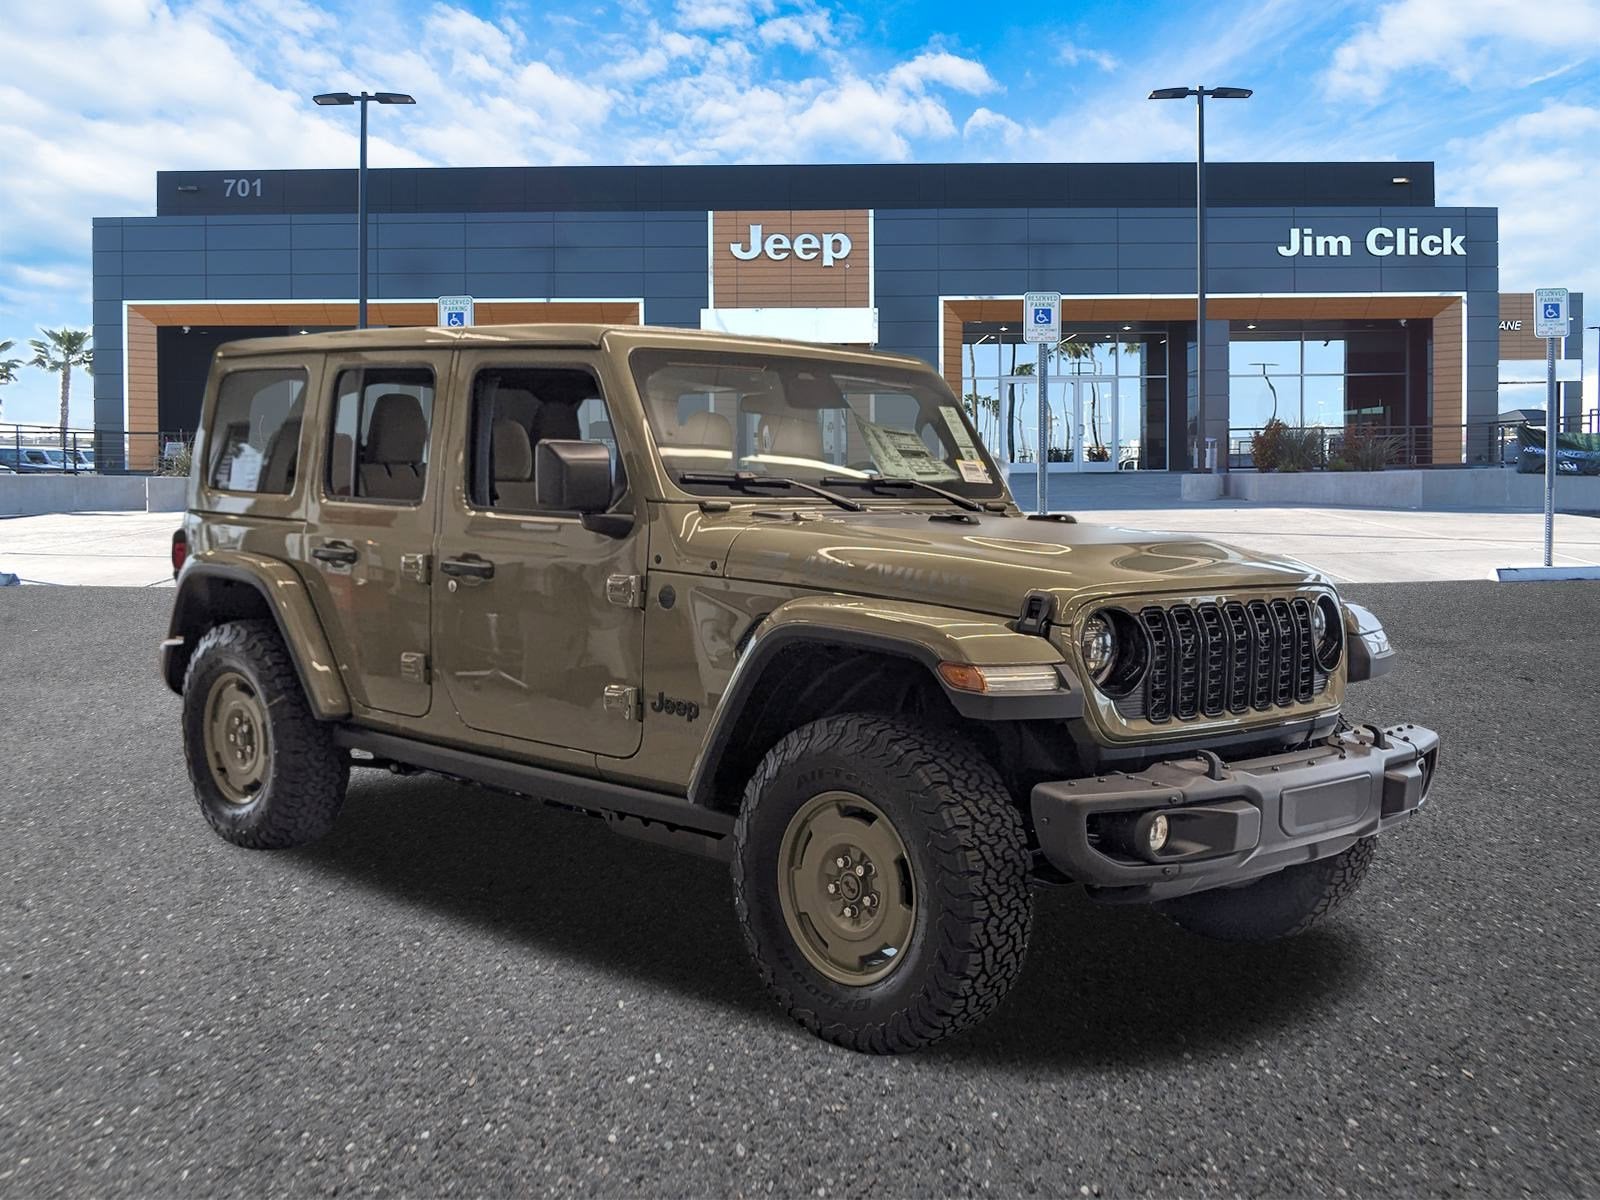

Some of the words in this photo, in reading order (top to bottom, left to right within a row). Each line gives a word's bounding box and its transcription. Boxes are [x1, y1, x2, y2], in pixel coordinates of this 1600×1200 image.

[223, 178, 263, 198] 701
[729, 223, 853, 268] Jeep
[1277, 227, 1352, 257] Jim
[1365, 226, 1468, 257] Click
[650, 691, 700, 723] Jeep
